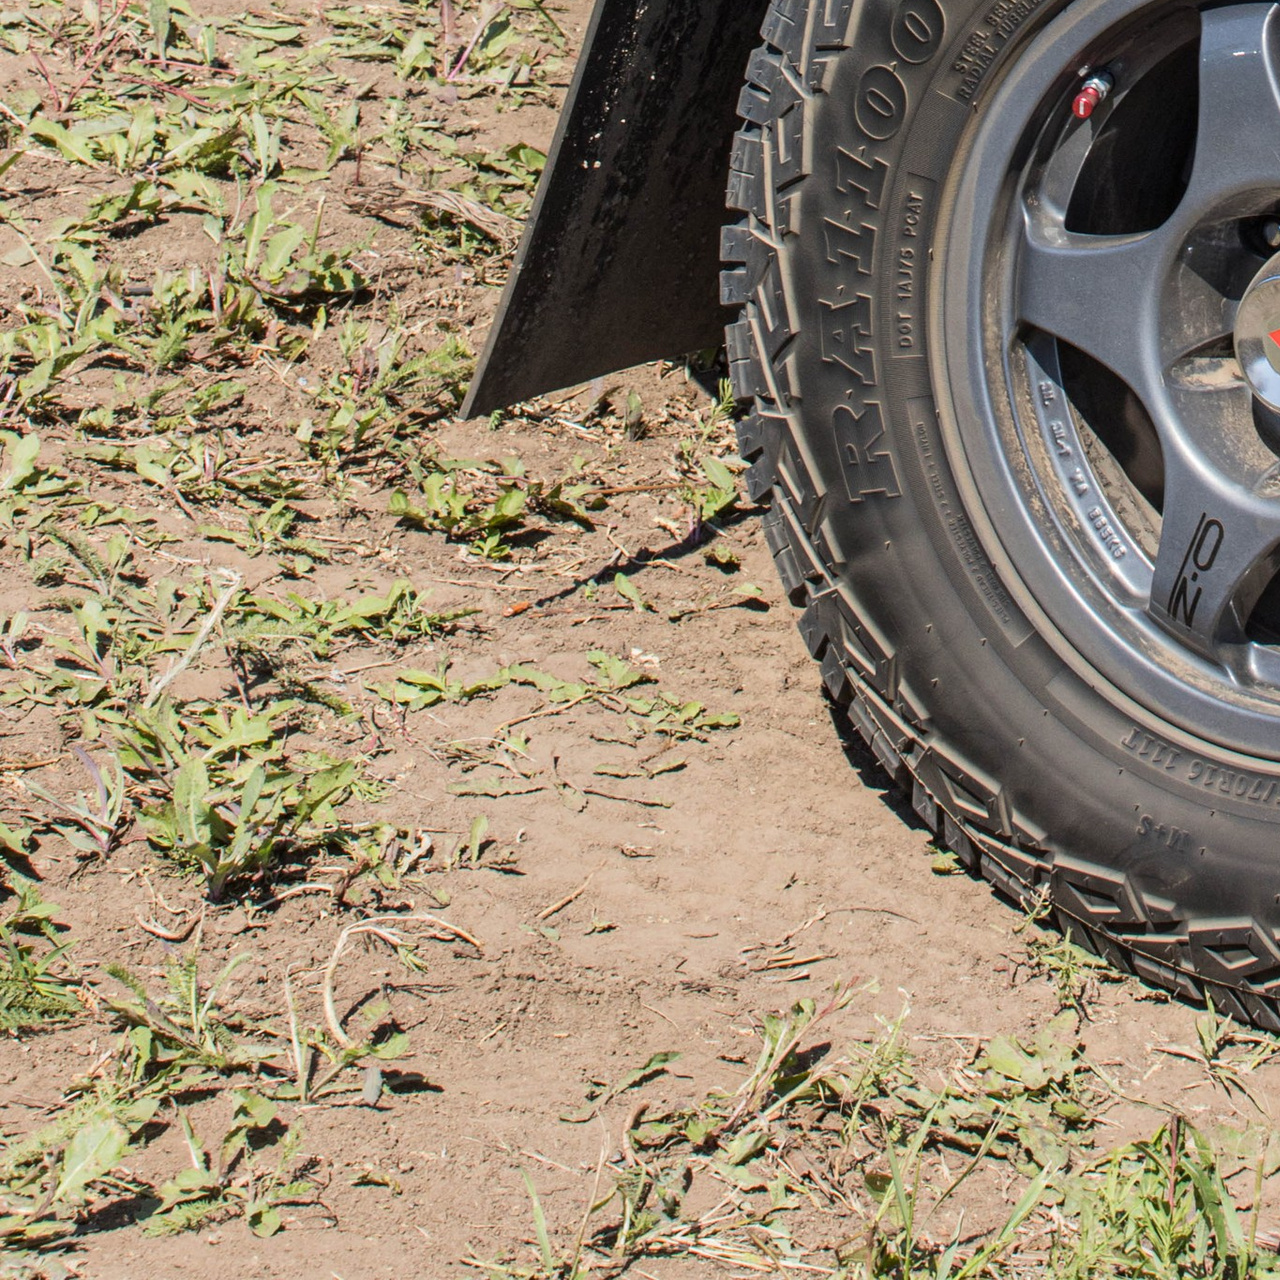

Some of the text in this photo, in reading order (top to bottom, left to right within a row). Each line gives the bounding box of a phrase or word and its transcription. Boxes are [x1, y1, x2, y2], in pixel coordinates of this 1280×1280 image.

[954, 29, 991, 75] STEEL
[957, 46, 999, 100] RADIAL
[896, 313, 912, 348] DOT
[1121, 726, 1181, 770] 111T
